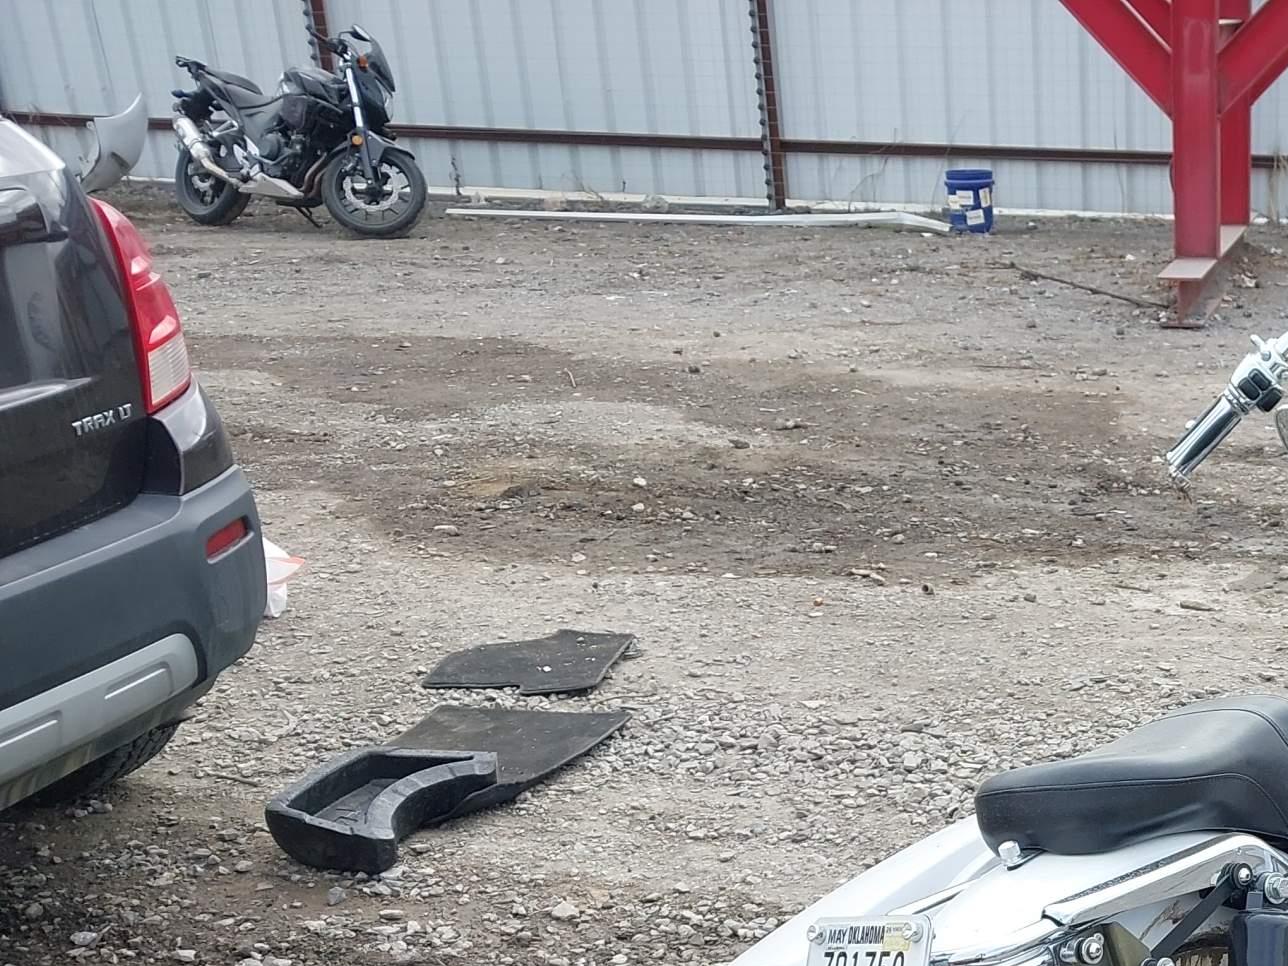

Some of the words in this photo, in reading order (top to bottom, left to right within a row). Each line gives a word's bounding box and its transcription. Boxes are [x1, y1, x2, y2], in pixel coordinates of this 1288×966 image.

[71, 409, 115, 436] TRAX
[118, 403, 132, 420] LT
[828, 929, 848, 944] MAY
[848, 925, 886, 945] OKLAHOMA
